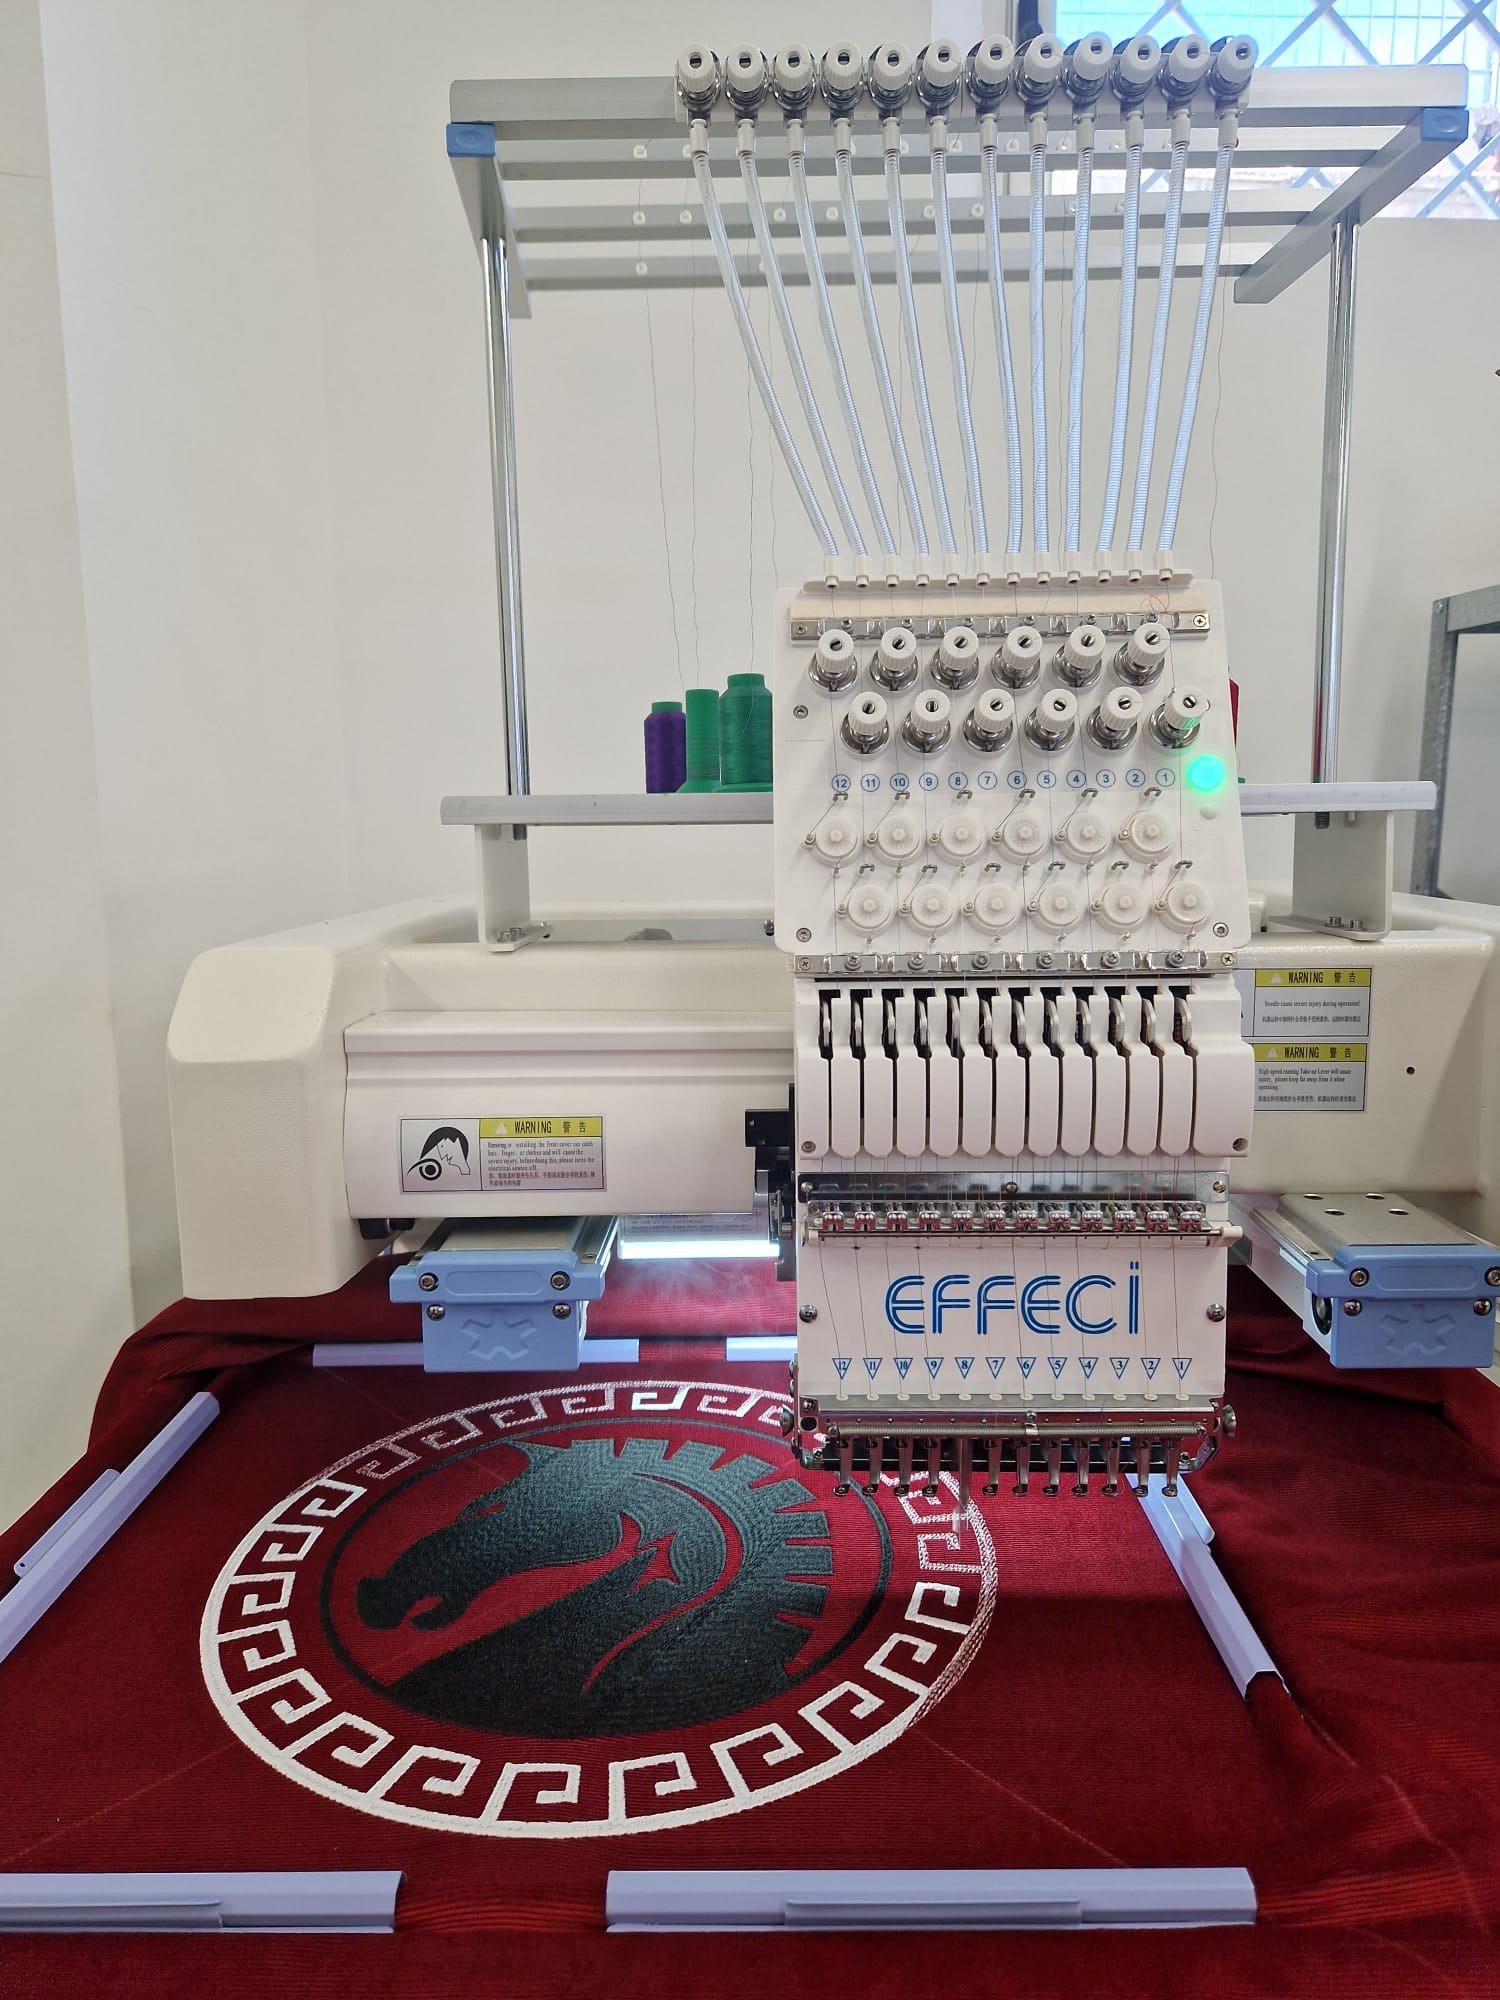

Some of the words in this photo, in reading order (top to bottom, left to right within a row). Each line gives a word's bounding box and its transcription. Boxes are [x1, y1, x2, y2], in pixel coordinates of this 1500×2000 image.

[1288, 971, 1324, 984] WARNING
[1284, 1046, 1320, 1059] WARNING
[514, 1120, 552, 1134] WARNING
